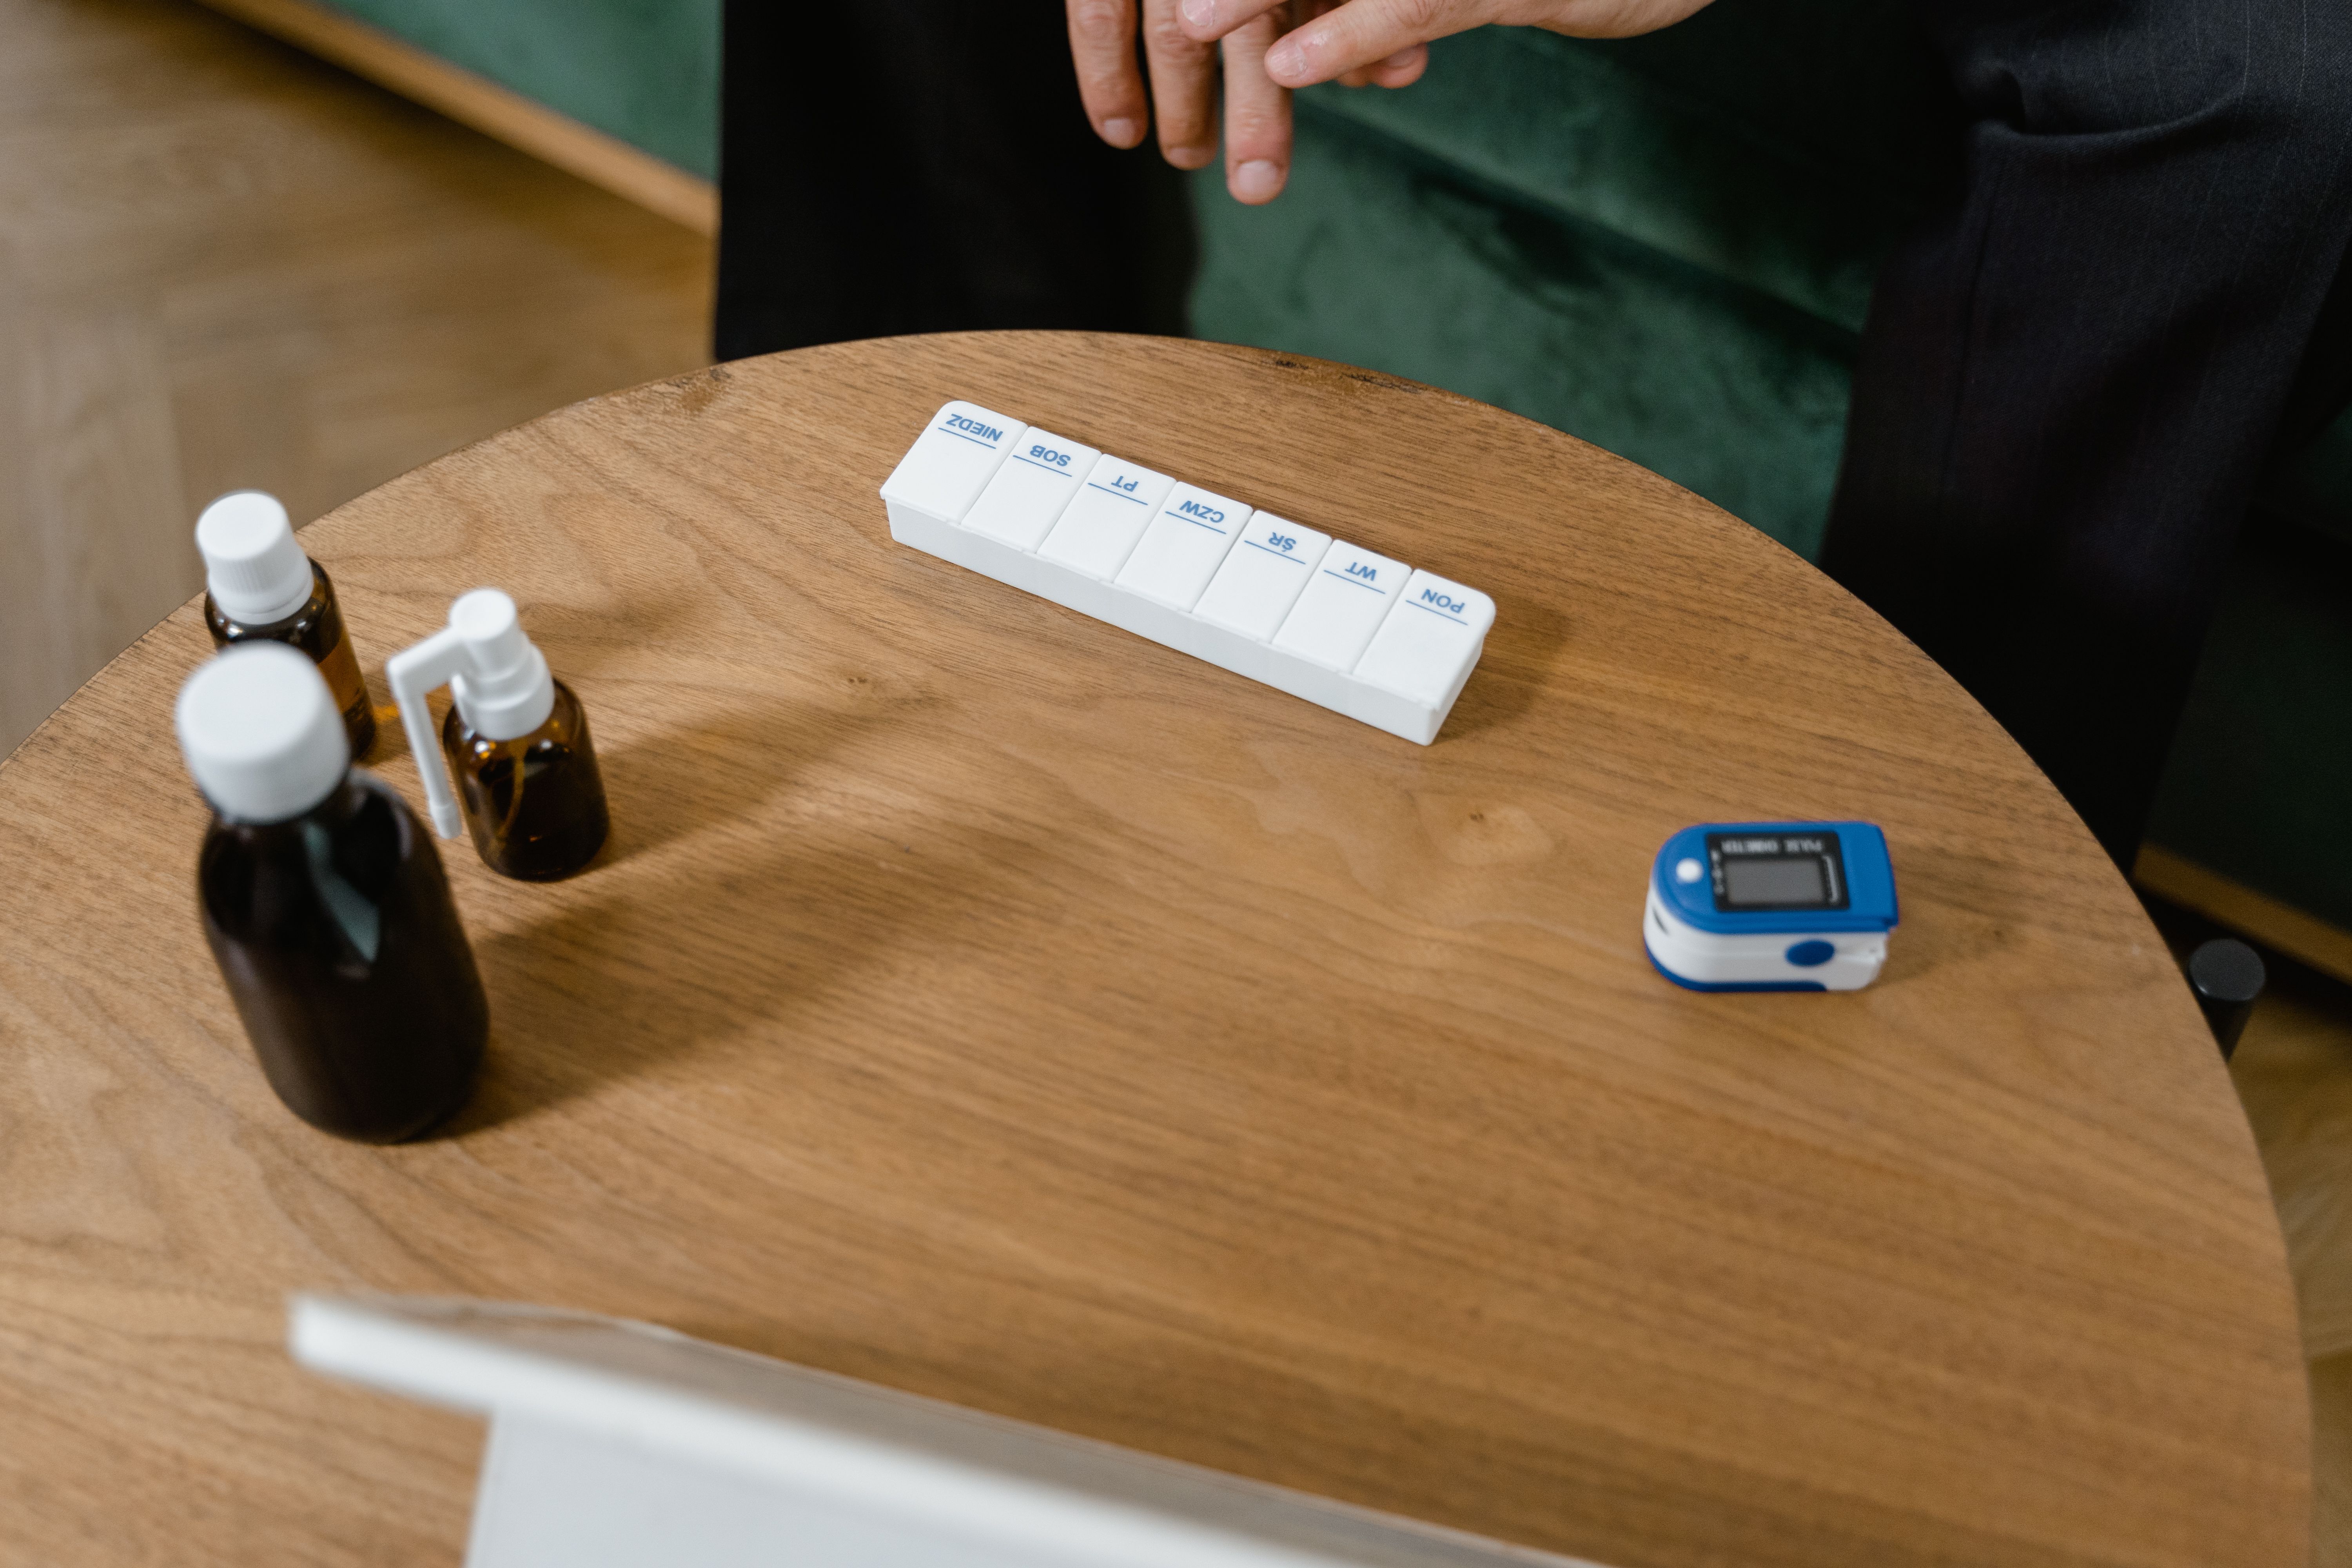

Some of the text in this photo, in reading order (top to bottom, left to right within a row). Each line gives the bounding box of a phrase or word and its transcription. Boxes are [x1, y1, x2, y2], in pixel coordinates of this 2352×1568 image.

[946, 413, 1004, 442] NIEDZ
[1029, 445, 1071, 467] SOB
[1111, 475, 1139, 492] PT
[1179, 500, 1225, 523] CZW
[1268, 532, 1297, 553] ŚR
[1345, 561, 1377, 581] WT
[1421, 588, 1465, 614] PON
